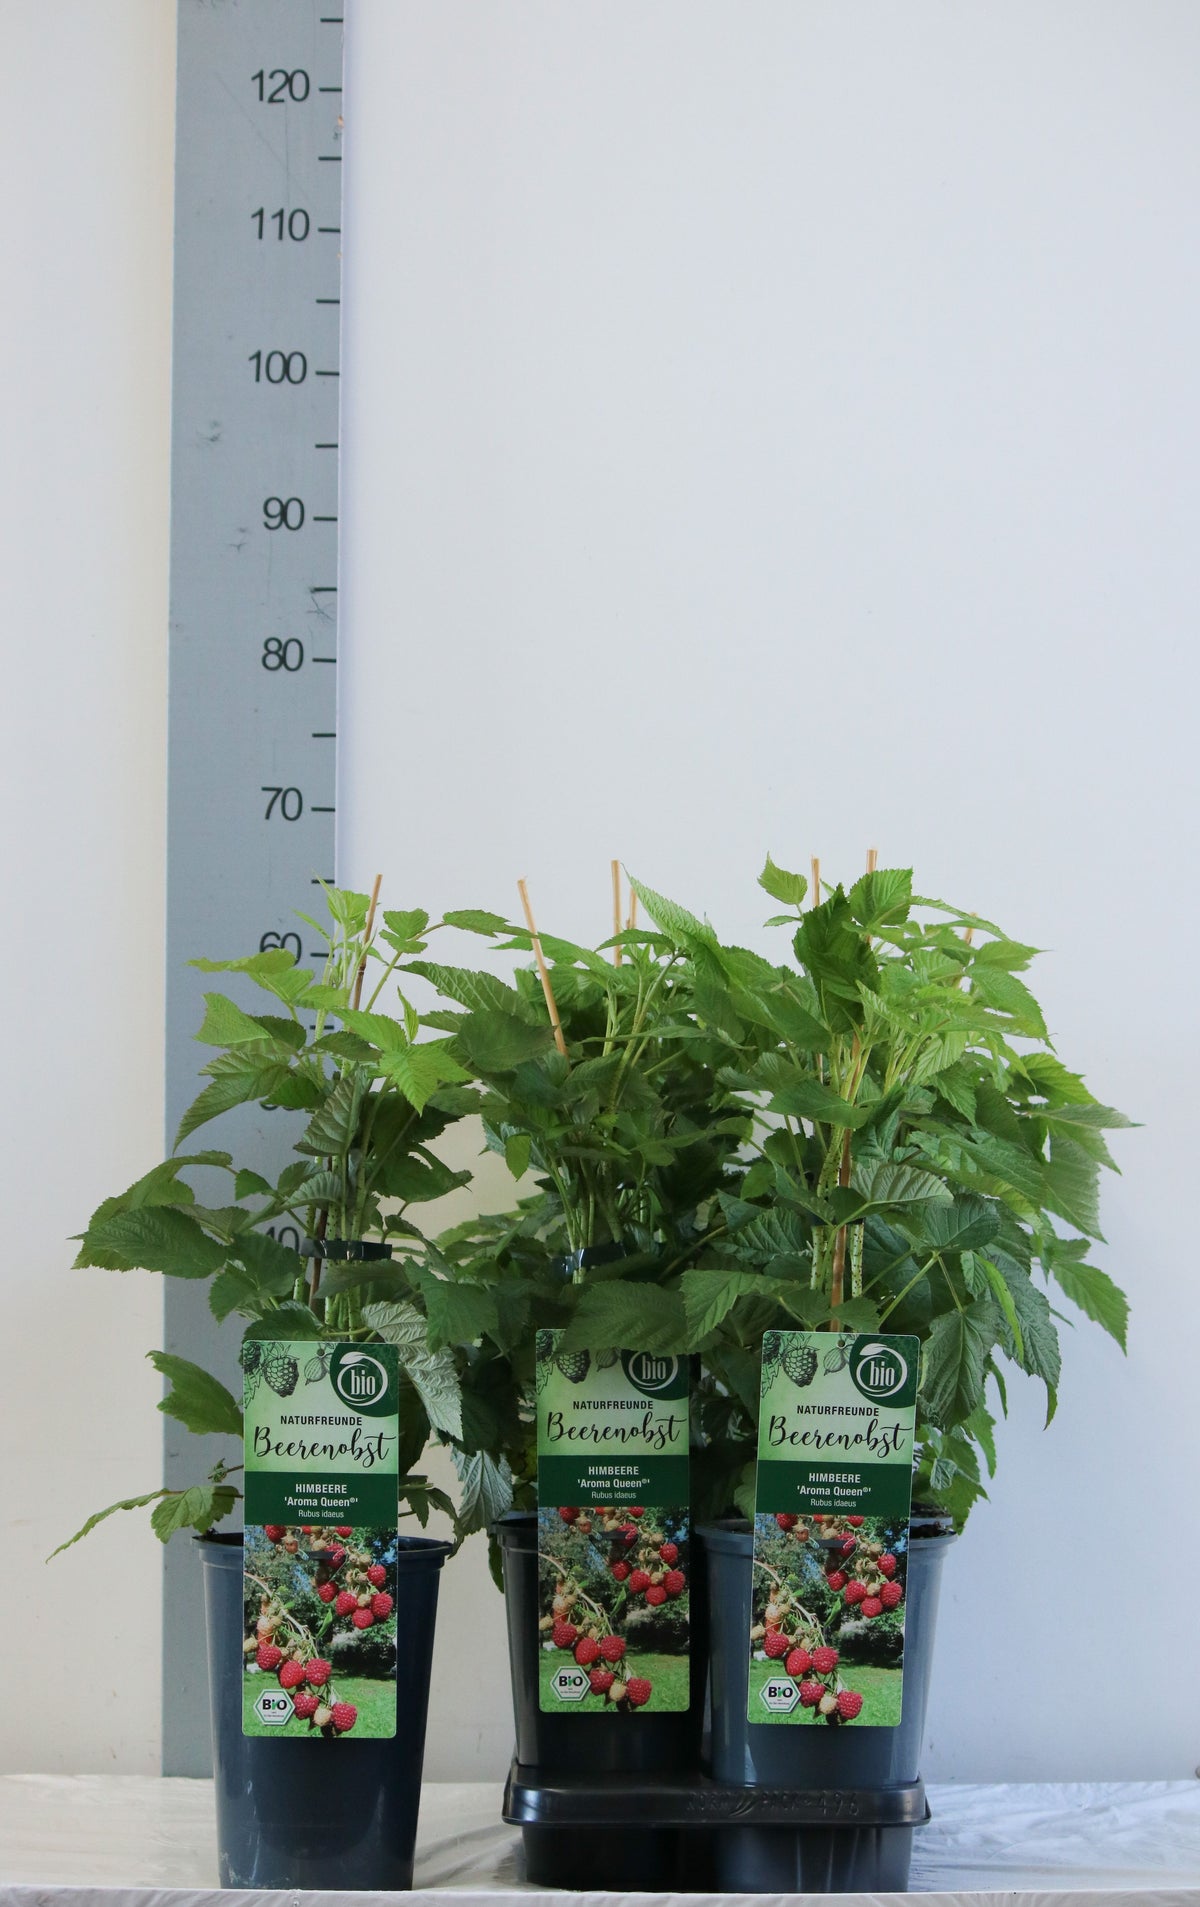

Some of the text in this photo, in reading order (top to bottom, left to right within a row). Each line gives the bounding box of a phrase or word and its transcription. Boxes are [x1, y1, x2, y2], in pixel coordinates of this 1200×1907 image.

[251, 69, 310, 104] 120
[250, 207, 310, 241] 110
[248, 350, 307, 384] 100
[262, 497, 305, 531] 90
[261, 637, 304, 672] 80
[260, 786, 303, 821] 70
[260, 931, 302, 967] 60
[641, 1354, 667, 1380] bio
[869, 1361, 895, 1387] bio
[350, 1369, 376, 1396] bio
[572, 1400, 654, 1410] NATURFREUNDE
[796, 1405, 880, 1417] NATURFREUNDE
[280, 1415, 363, 1426] NATURFREUNDE
[547, 1411, 688, 1450] Beerenobst
[254, 1426, 397, 1468] Beerenobst
[768, 1415, 914, 1459] Beerenobst
[577, 1478, 611, 1488] 'Aroma
[588, 1466, 640, 1475] HIMBEERE
[808, 1472, 862, 1484] HIMBEERE
[284, 1496, 318, 1507] 'Aroma
[295, 1483, 348, 1494] HIMBEERE
[591, 1491, 637, 1499] Rubus idaeus
[797, 1485, 831, 1496] 'Aroma
[298, 1509, 345, 1519] Rubus idaeus
[810, 1498, 857, 1508] Rubus idaeus
